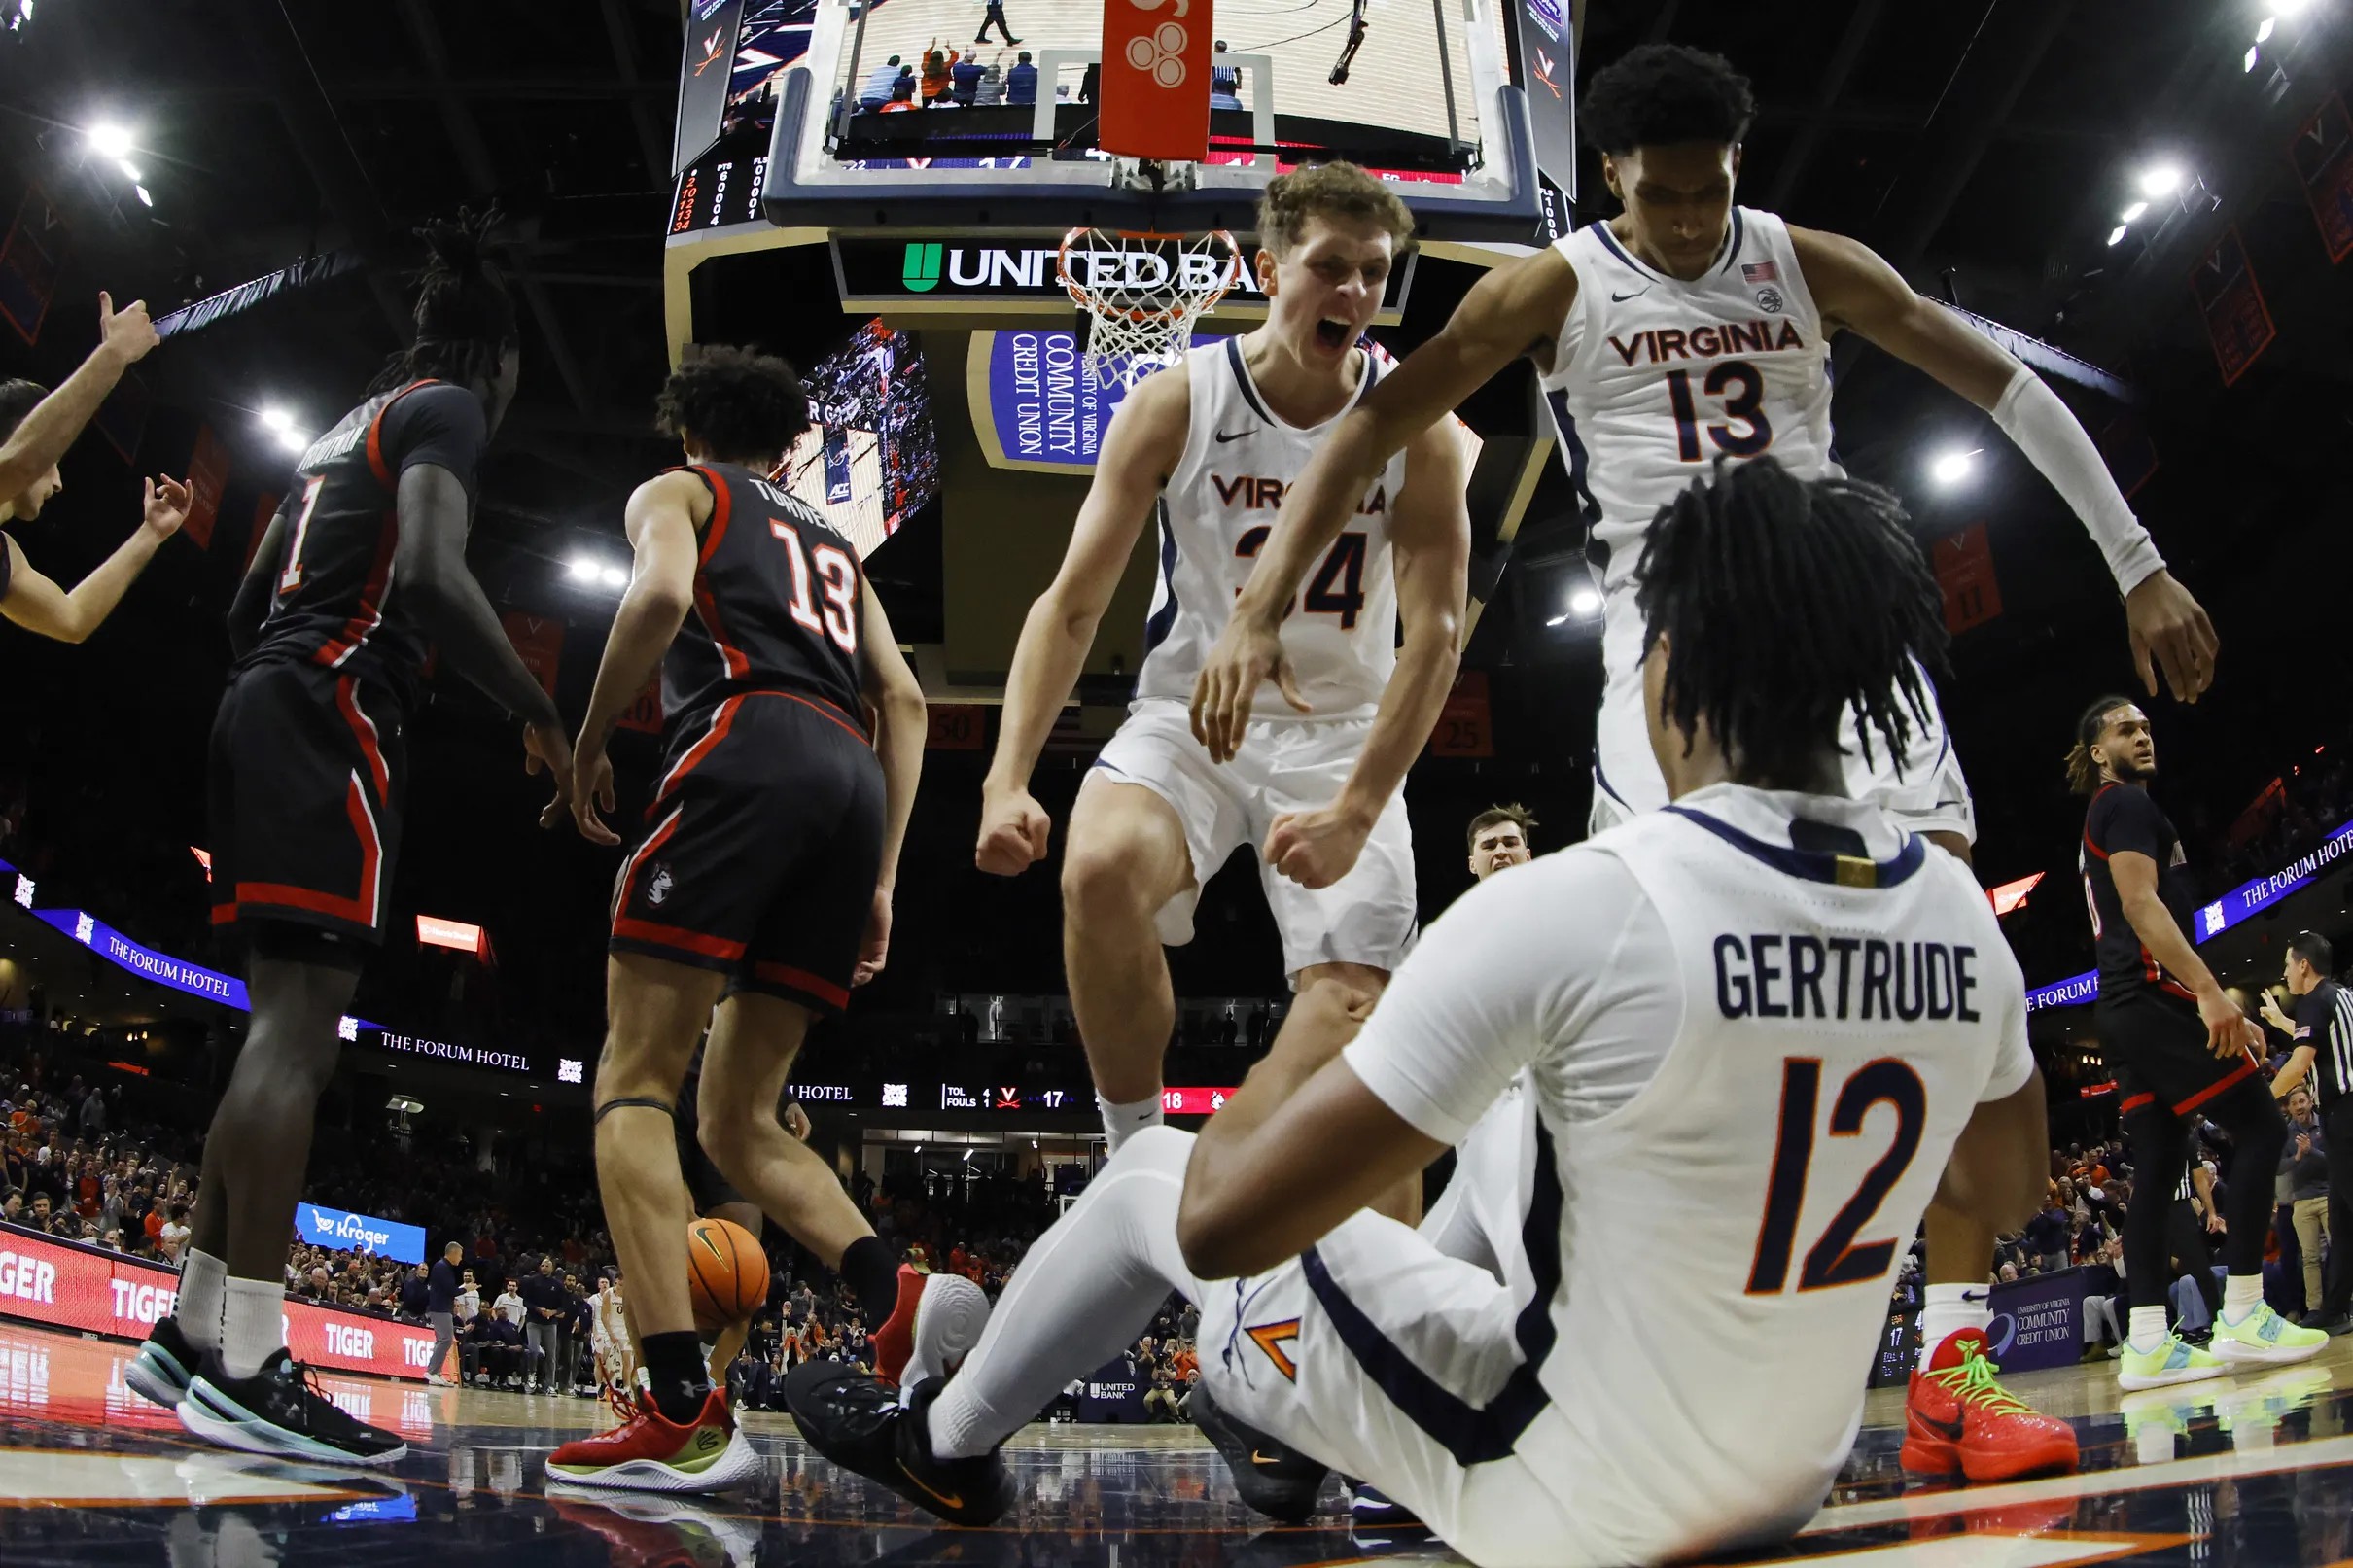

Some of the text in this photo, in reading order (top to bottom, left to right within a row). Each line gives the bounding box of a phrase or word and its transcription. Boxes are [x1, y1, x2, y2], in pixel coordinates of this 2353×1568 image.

[686, 164, 763, 188] 2 6 0
[717, 157, 768, 172] PTS FLS
[679, 188, 759, 210] 12 0 0
[682, 176, 761, 198] 10 0 0
[673, 209, 755, 232] 34 4 1
[677, 198, 756, 221] 13 0 0
[1546, 207, 1554, 218] 0
[1547, 219, 1556, 228] 0
[1549, 229, 1558, 239] 0
[949, 249, 1263, 293] UNITED BA
[1608, 318, 1805, 367] VIRGINIA
[1012, 333, 1042, 455] CREDIT UNION
[1045, 334, 1075, 455] COMMUNITY
[1082, 396, 1097, 410] OF
[1666, 360, 1773, 463] 13
[1082, 412, 1097, 455] VIRGINIA
[279, 473, 326, 595] 1
[768, 517, 860, 655] 13
[2242, 829, 2353, 908] THE FORUM HOTE
[109, 936, 230, 997] THE FORUM HOTEL
[1713, 933, 1981, 1023] GERTRUDE
[2037, 979, 2092, 1009] FORUM
[381, 1031, 530, 1071] THE FORUM HOTEL
[798, 1084, 853, 1100] HOTEL
[946, 1098, 990, 1108] FOULS 1
[947, 1086, 990, 1098] TOL 4
[1043, 1090, 1064, 1108] 17
[1163, 1092, 1182, 1110] 18
[1744, 1056, 1927, 1296] 12
[336, 1214, 390, 1254] Kroger
[0, 1250, 56, 1304] GER
[111, 1278, 179, 1324] TIGE
[2017, 1307, 2070, 1331] COMMUNITY
[325, 1323, 374, 1360] TIGER
[1890, 1327, 1903, 1347] 17
[2017, 1326, 2070, 1346] CREDIT UNION
[403, 1337, 437, 1368] TIGE
[1100, 1391, 1126, 1400] BANK
